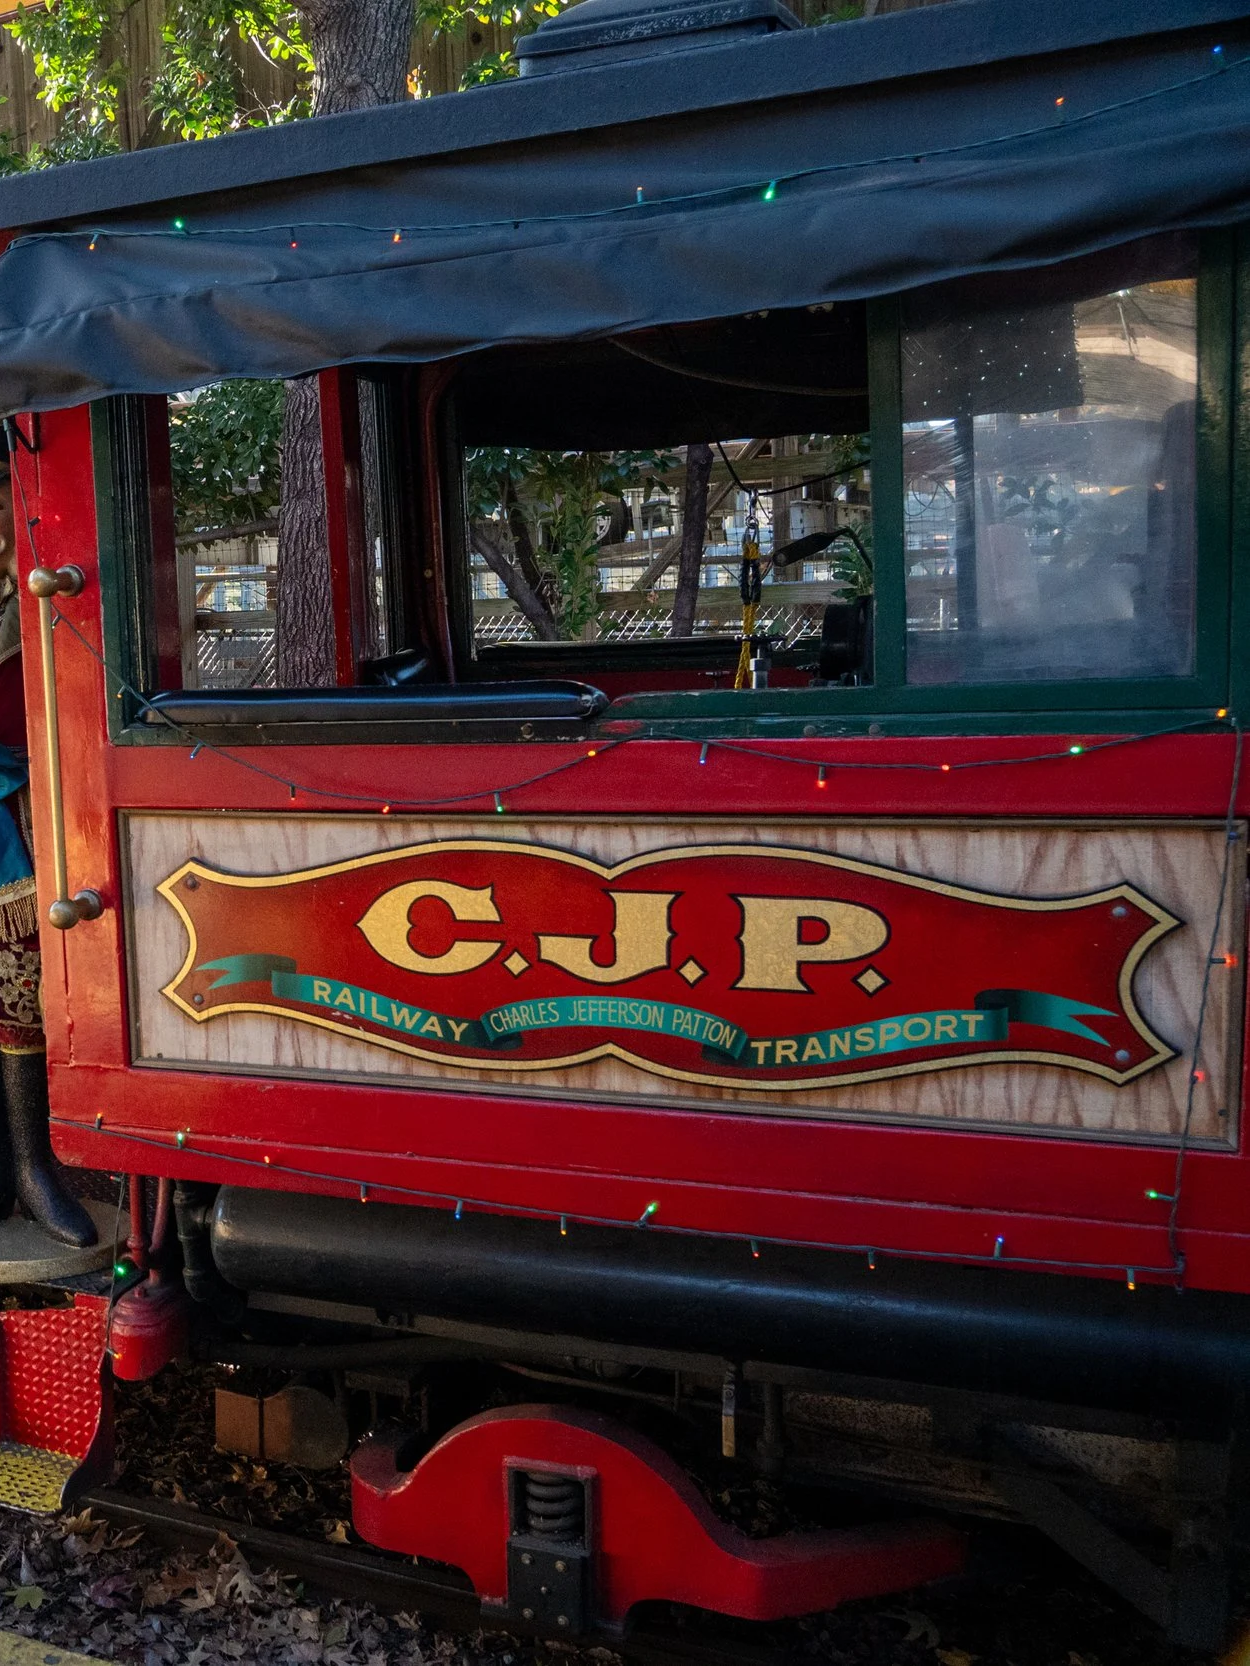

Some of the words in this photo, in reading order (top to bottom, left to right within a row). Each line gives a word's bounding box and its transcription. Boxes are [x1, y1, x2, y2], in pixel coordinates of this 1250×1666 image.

[354, 878, 892, 996] C.J.P.
[313, 979, 469, 1042] RAILWAY
[489, 1002, 560, 1033] CHARLES
[567, 1000, 665, 1029] JEFFERSON
[671, 1008, 738, 1049] PATTON
[750, 1014, 984, 1065] TRANSPORT
